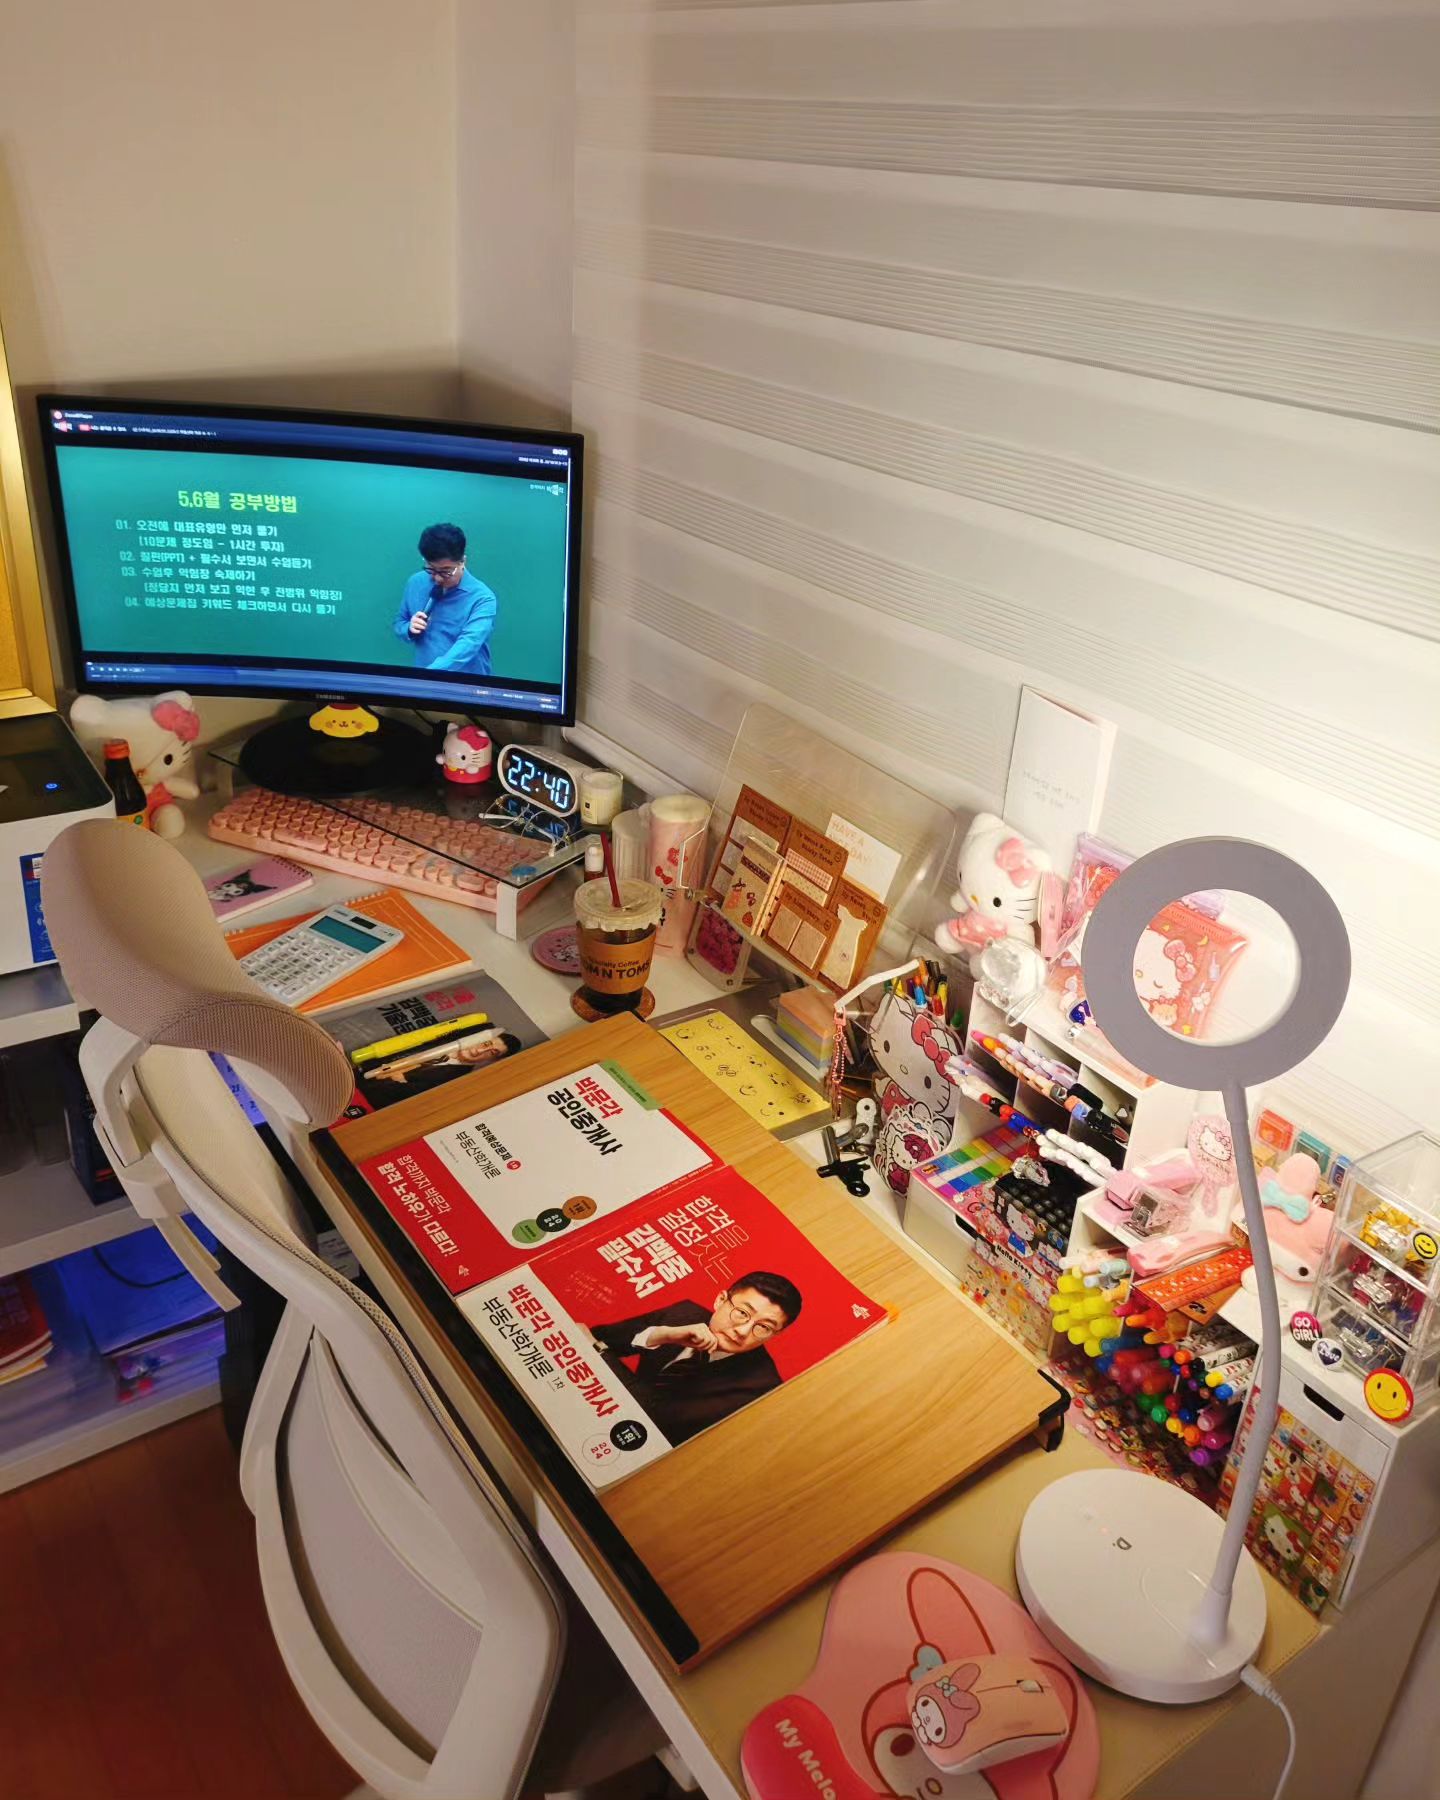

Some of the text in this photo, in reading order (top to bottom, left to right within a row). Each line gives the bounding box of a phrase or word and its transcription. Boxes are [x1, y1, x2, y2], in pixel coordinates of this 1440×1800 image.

[178, 490, 297, 513] 5.6월 공부방법
[174, 521, 226, 534] 대표유형만
[231, 524, 252, 536] 먼저
[230, 540, 256, 552] 1시간
[142, 567, 174, 578] 수업후
[214, 569, 256, 581] 숙제하기
[236, 555, 267, 567] 보면서
[272, 556, 312, 570] 수업듣기
[184, 583, 206, 594] 먼저
[210, 584, 230, 594] 보고
[292, 602, 312, 614] 다시
[508, 754, 570, 809] 22:40
[574, 1076, 624, 1119] 박문각
[547, 1088, 624, 1157] 공인중개사
[454, 1130, 502, 1180] 부동산학개론
[475, 1122, 513, 1162] 합격예상문제
[396, 1154, 432, 1190] 합격까지
[424, 1186, 452, 1214] 박문각
[378, 1162, 460, 1257] 합격 노하우가 다르다!
[544, 1218, 555, 1227] 24
[551, 1214, 562, 1224] 20
[684, 1195, 750, 1250] 합격을
[625, 1223, 694, 1284] 김백중
[658, 1208, 734, 1284] 결정짓는
[596, 1237, 666, 1299] 필수서
[1293, 1328, 1320, 1342] GIRL!
[1294, 1316, 1311, 1328] GO
[482, 1296, 554, 1380] 부동산학개론
[508, 1284, 555, 1334] 박문각
[542, 1330, 620, 1418] 공인중개사
[599, 1442, 611, 1454] 20
[622, 1428, 636, 1443] 1위
[591, 1446, 603, 1459] 24
[774, 1718, 803, 1749] My
